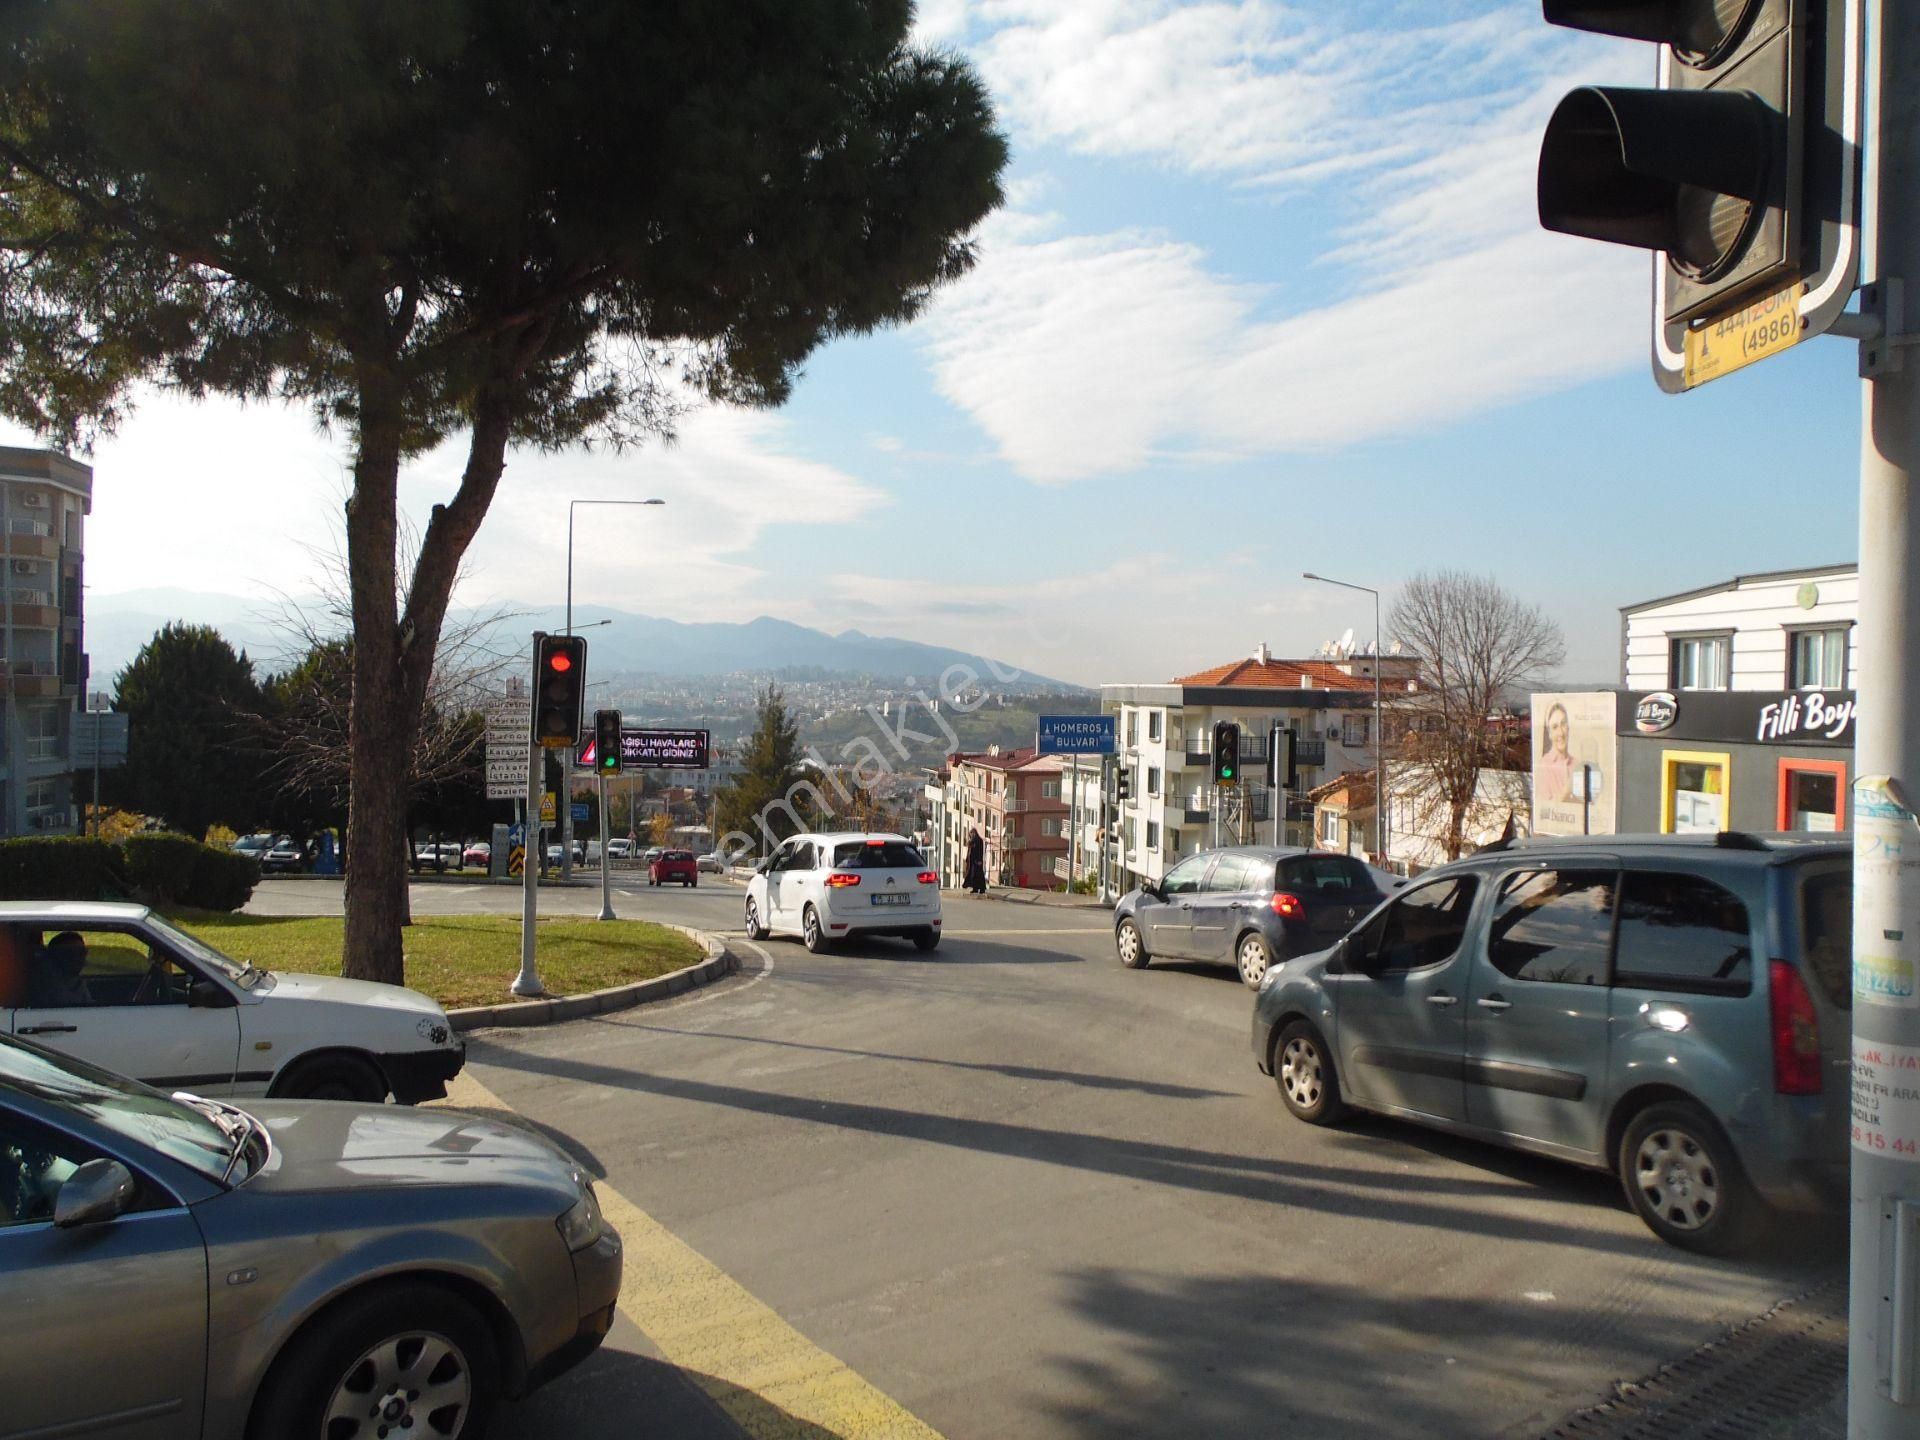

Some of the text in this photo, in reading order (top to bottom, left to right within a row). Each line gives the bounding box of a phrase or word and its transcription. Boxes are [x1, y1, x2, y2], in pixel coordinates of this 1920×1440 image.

[1742, 307, 1797, 358] (4986)
[1757, 695, 1801, 741] Filli
[1053, 723, 1102, 734] HOMEROS
[649, 739, 703, 748] HAVALARDA
[1056, 737, 1099, 748] BULVARI
[1865, 1131, 1886, 1150] 15
